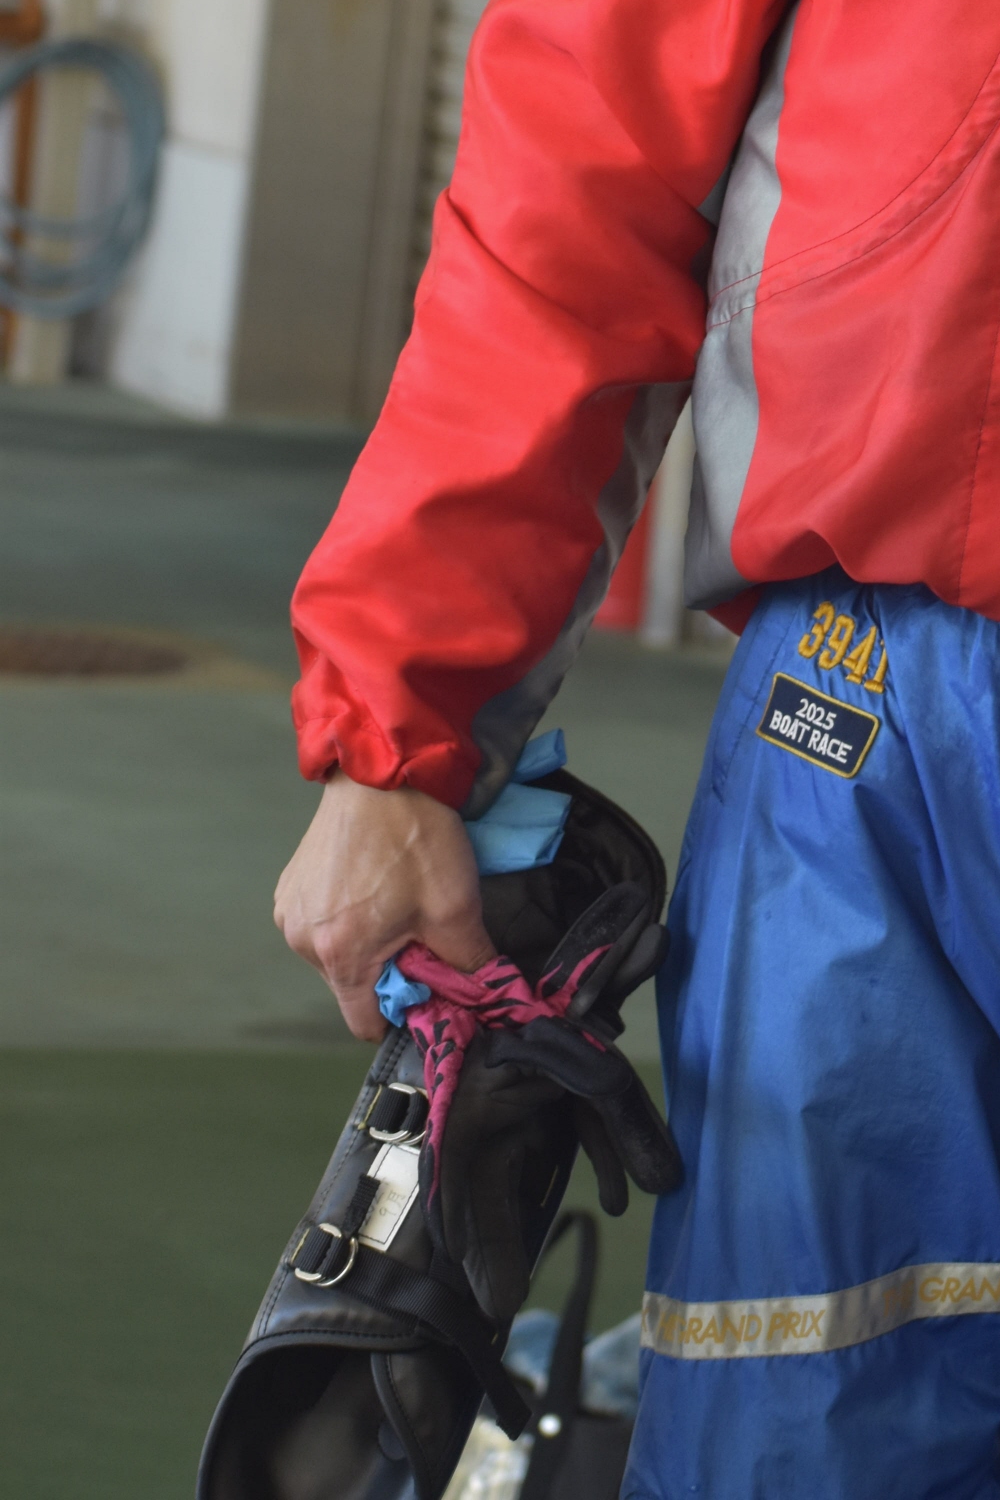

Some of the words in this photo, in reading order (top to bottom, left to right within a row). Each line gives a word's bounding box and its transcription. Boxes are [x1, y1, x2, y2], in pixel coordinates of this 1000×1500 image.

[798, 600, 888, 694] 3941
[795, 698, 837, 731] 2025
[769, 709, 811, 743] BOAT
[807, 729, 853, 764] RACE
[379, 1190, 407, 1217] 9月
[766, 1309, 827, 1342] PRIX
